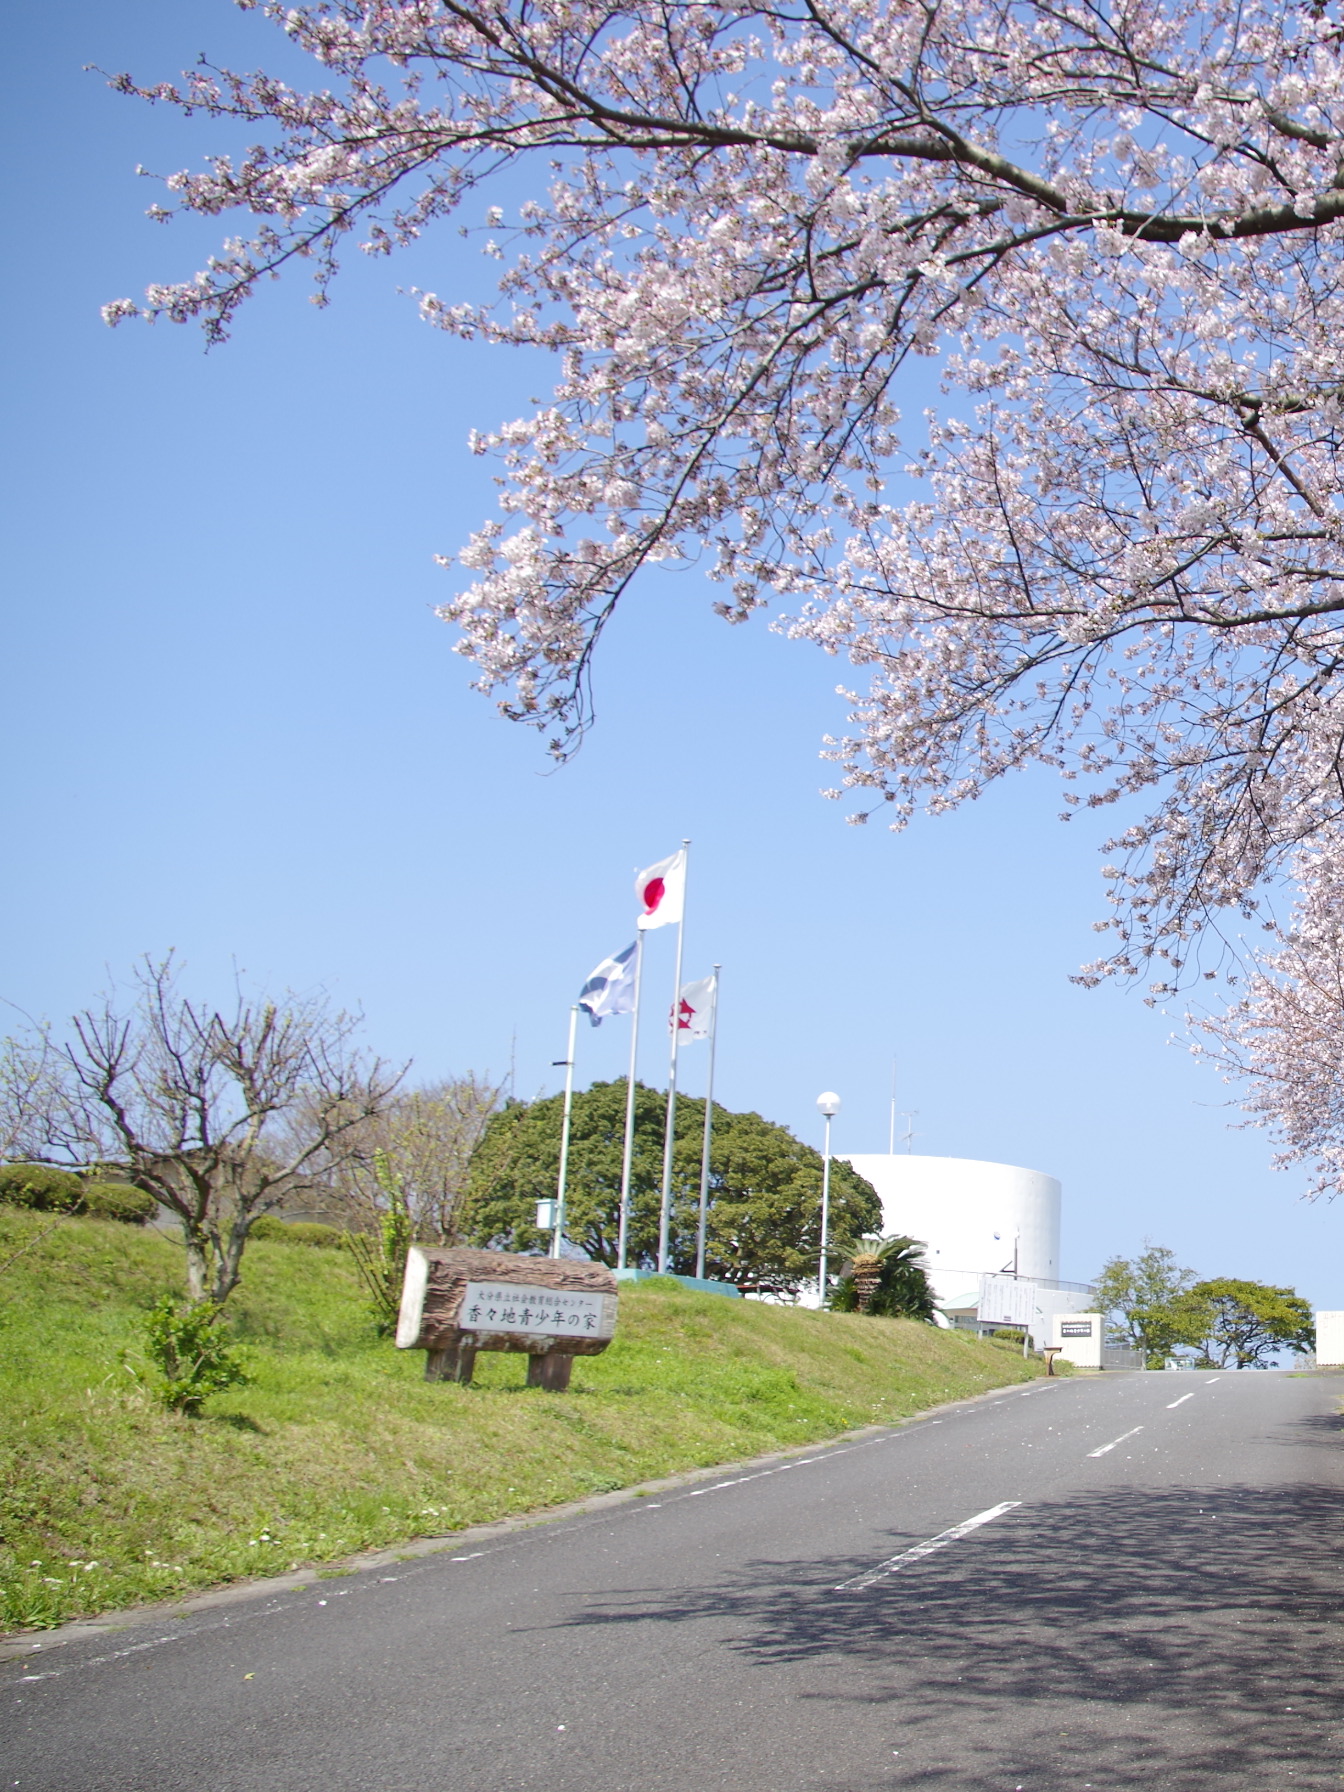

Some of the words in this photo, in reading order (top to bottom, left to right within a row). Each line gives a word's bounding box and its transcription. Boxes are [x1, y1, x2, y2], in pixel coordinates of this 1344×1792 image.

[468, 1304, 598, 1330] 香々地青少年の家
